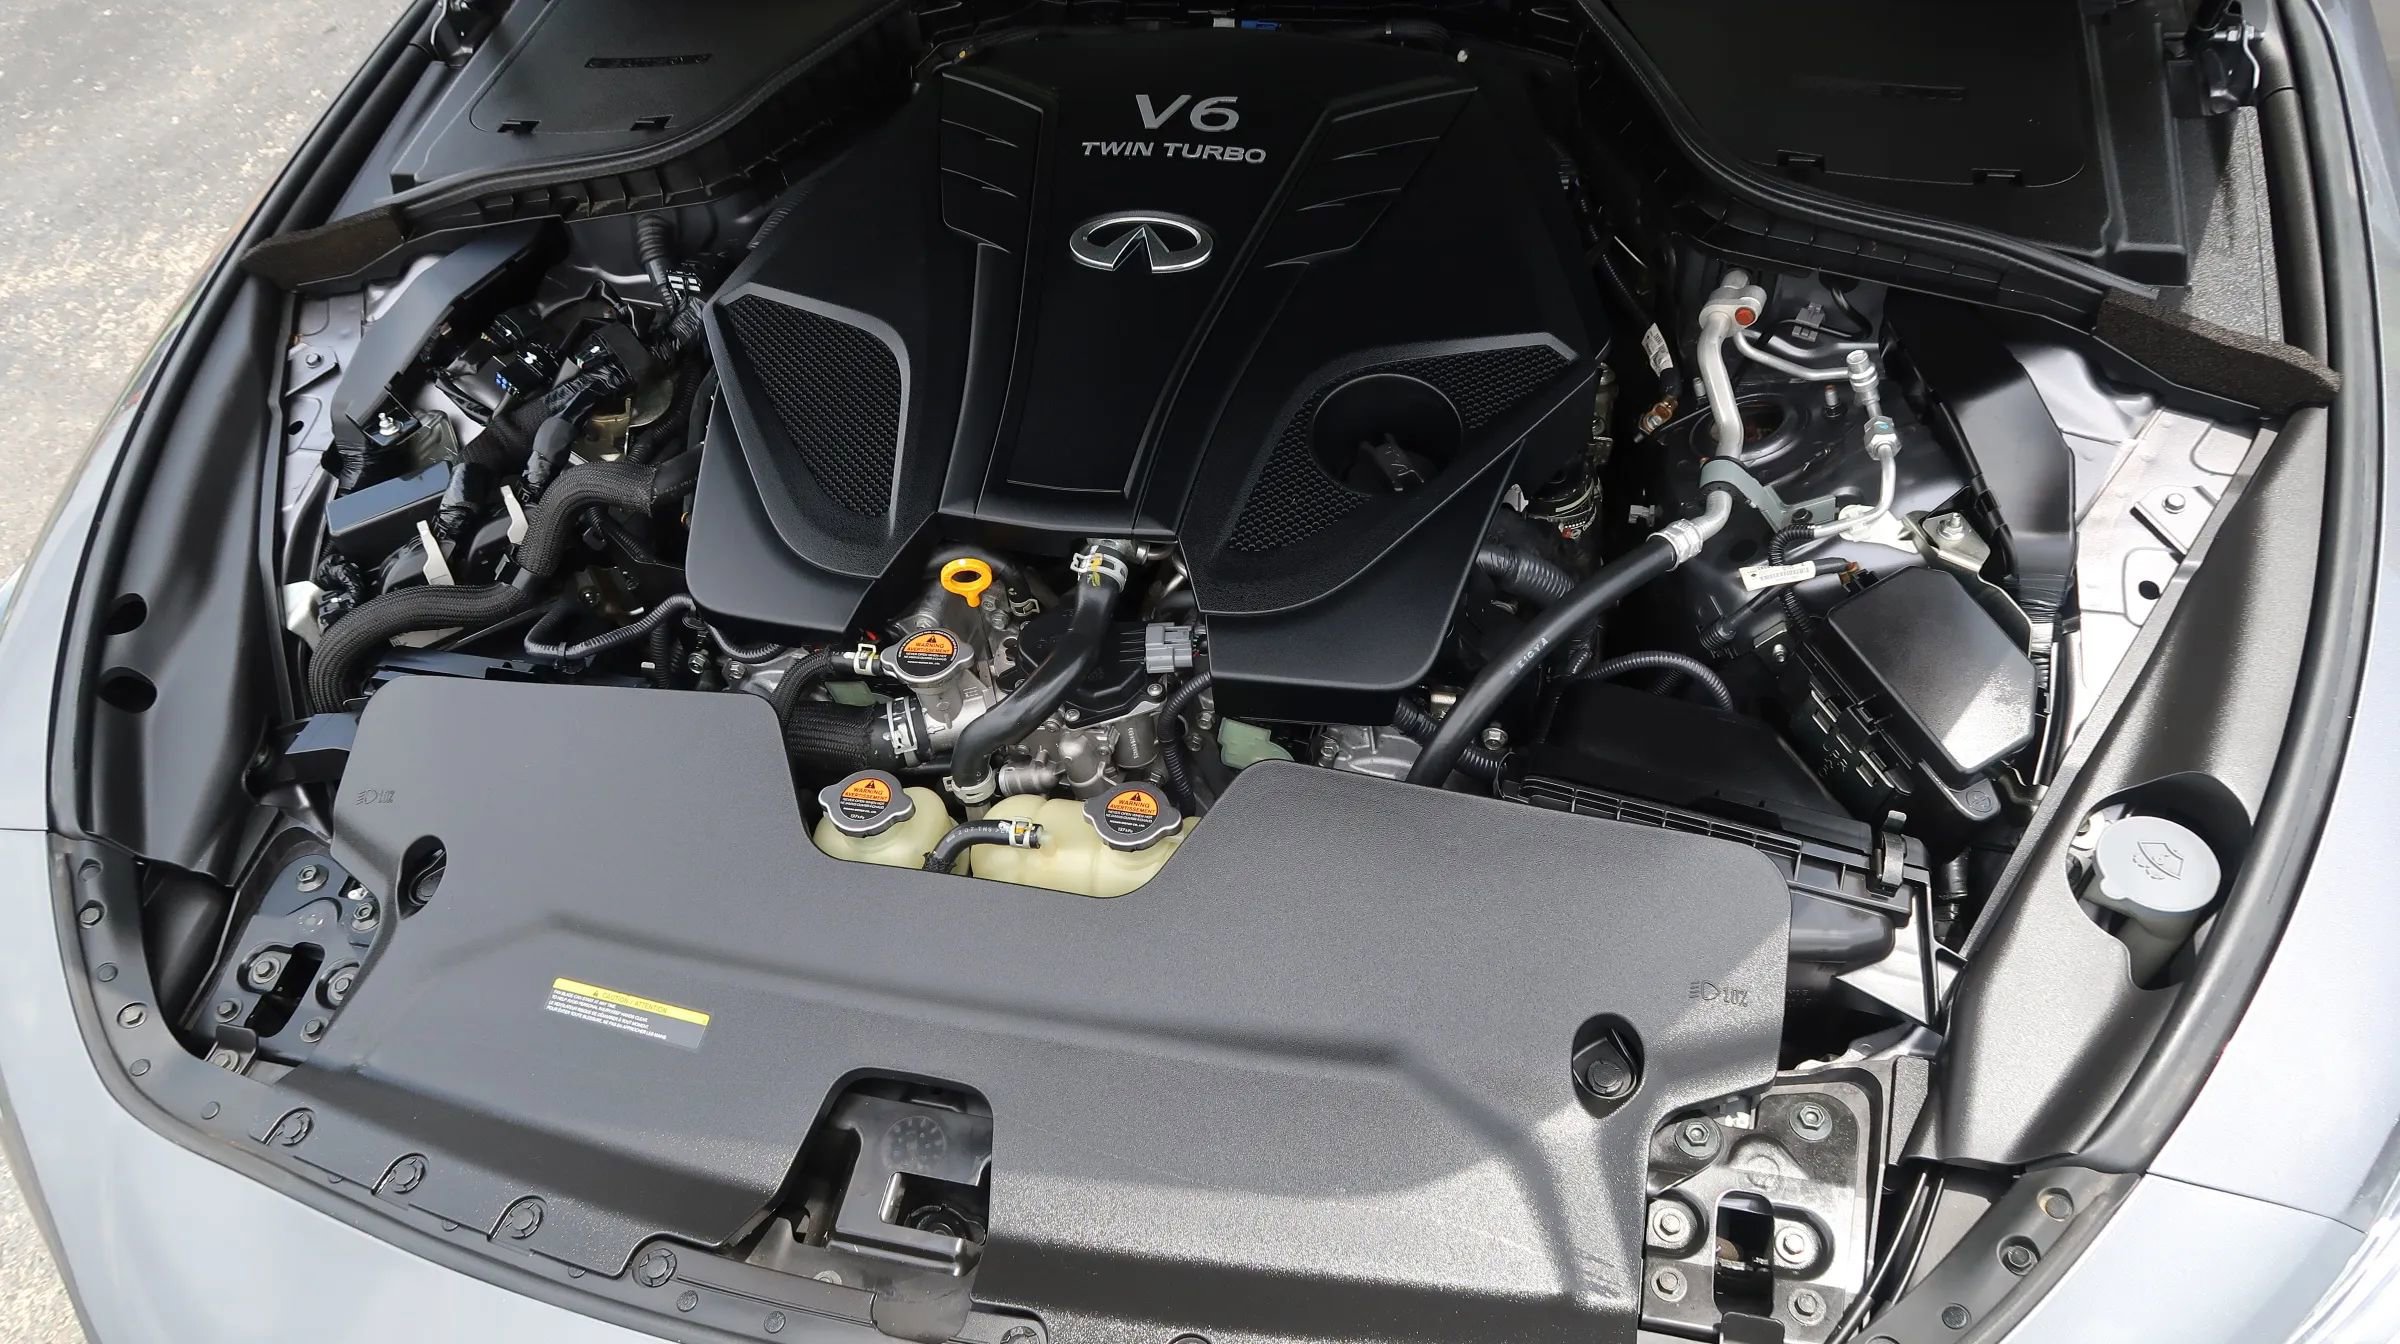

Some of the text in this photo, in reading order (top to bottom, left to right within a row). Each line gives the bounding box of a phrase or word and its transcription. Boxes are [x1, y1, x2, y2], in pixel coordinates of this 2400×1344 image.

[1135, 94, 1240, 132] V6
[1081, 141, 1267, 163] TWIN TURBO
[853, 787, 883, 795] WARNING
[1109, 804, 1156, 814] AVERTISSEMENT
[1118, 799, 1150, 809] WARNING
[601, 992, 628, 1004] CAUTION
[633, 1000, 668, 1014] ATTENTION
